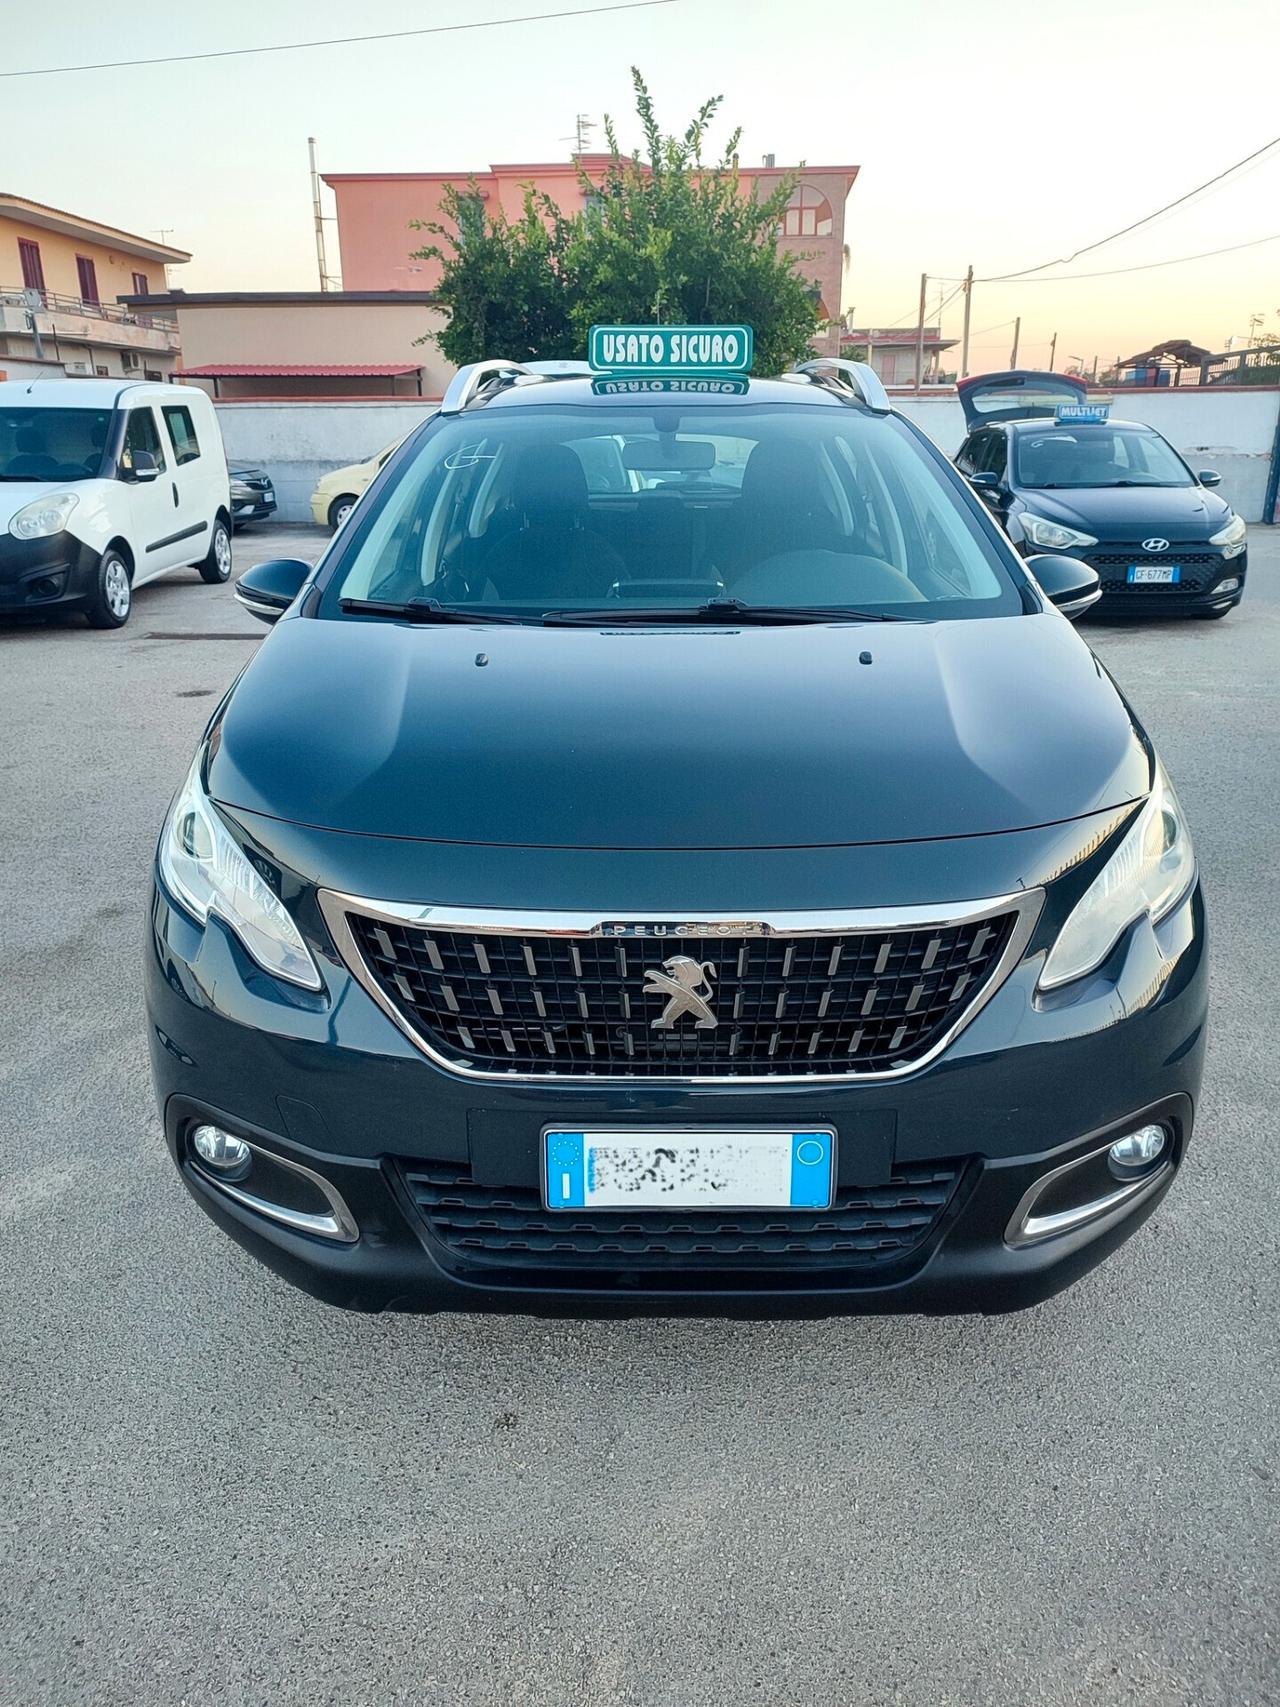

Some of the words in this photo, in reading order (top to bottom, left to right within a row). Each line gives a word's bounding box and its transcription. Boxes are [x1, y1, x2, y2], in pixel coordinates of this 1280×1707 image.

[603, 334, 664, 363] USATO
[670, 334, 739, 363] SICURO
[1061, 406, 1106, 417] MULTIJET
[613, 925, 753, 936] PEUGEOT
